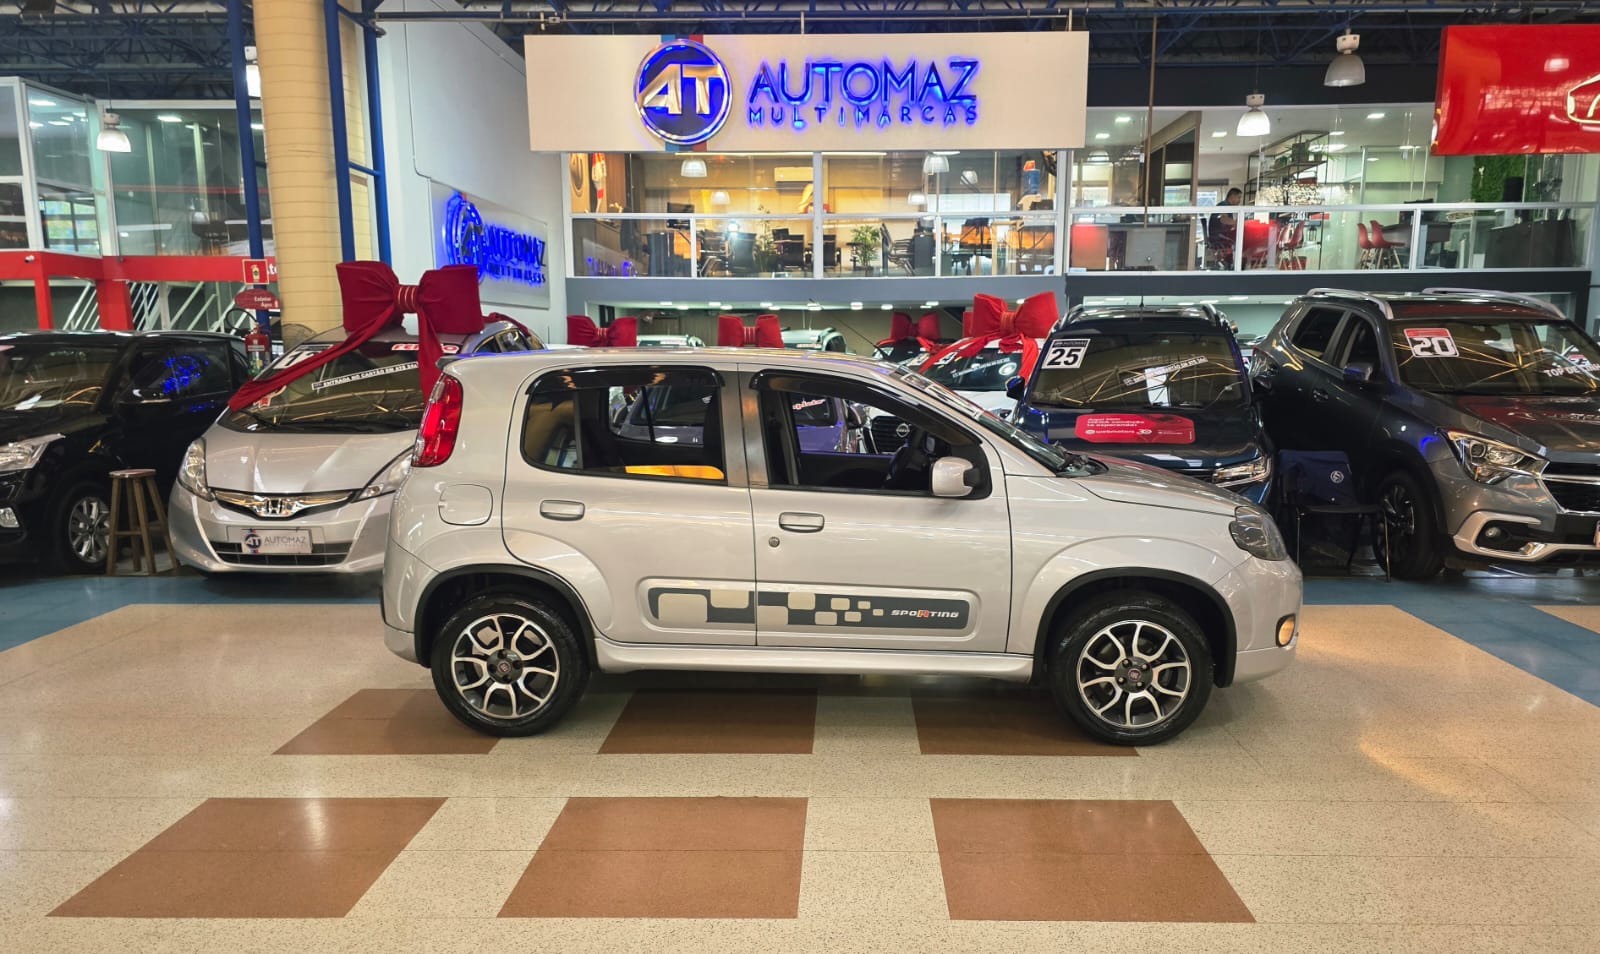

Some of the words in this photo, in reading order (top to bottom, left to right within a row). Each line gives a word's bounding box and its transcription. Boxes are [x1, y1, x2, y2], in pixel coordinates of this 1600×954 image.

[748, 59, 979, 104] AUTOMAZ
[748, 105, 978, 126] MULTIMARCAS
[1412, 337, 1456, 356] 20
[1046, 348, 1081, 366] 25
[264, 535, 306, 544] AUTOMAZ
[891, 609, 960, 618] SPORTING
